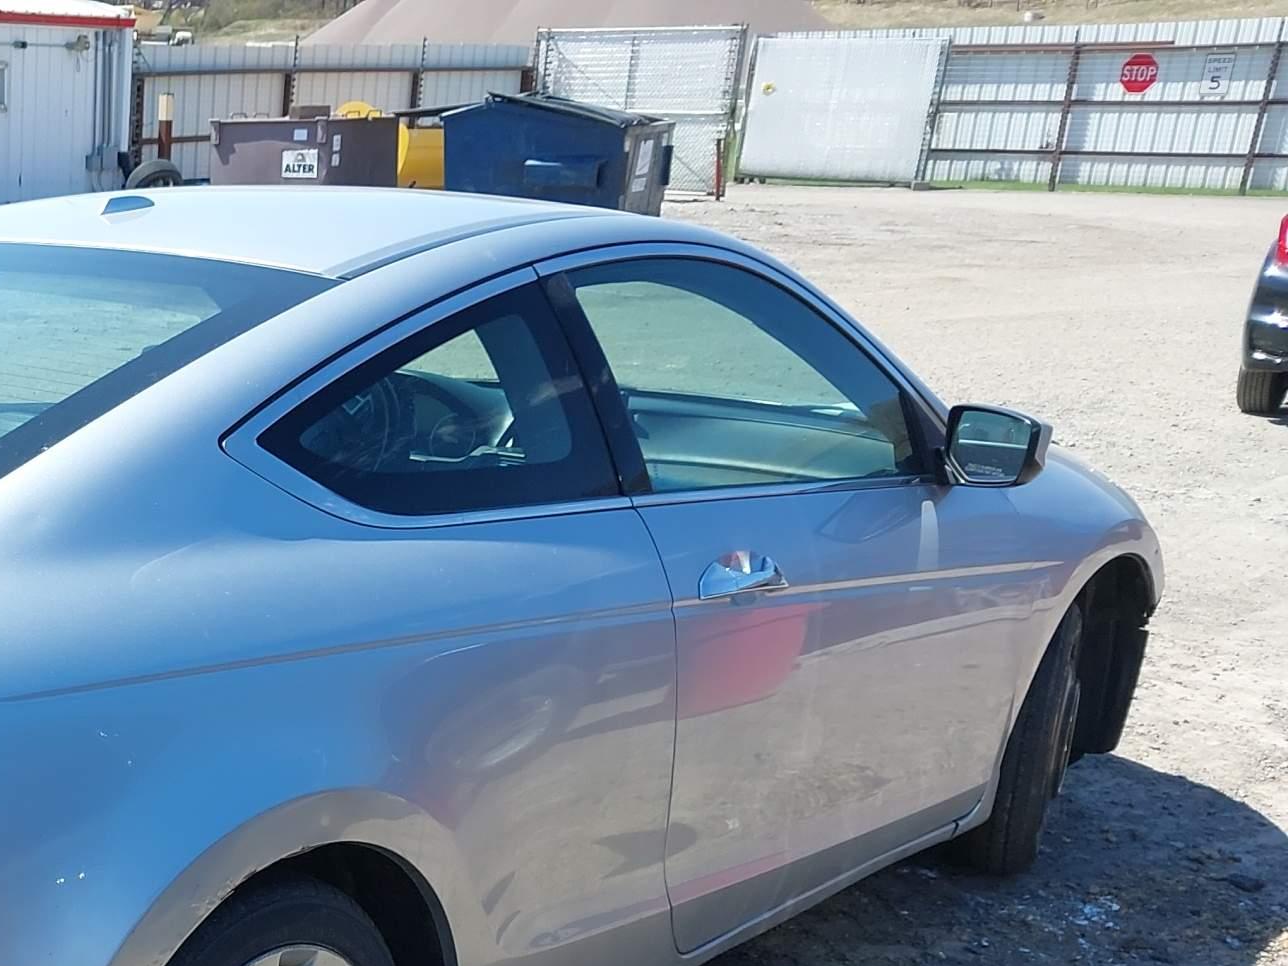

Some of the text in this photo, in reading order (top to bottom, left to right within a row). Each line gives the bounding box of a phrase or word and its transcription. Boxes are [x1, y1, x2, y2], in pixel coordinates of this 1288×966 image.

[1122, 65, 1157, 81] STOP
[1208, 75, 1221, 90] 5
[284, 163, 315, 174] ALTER
